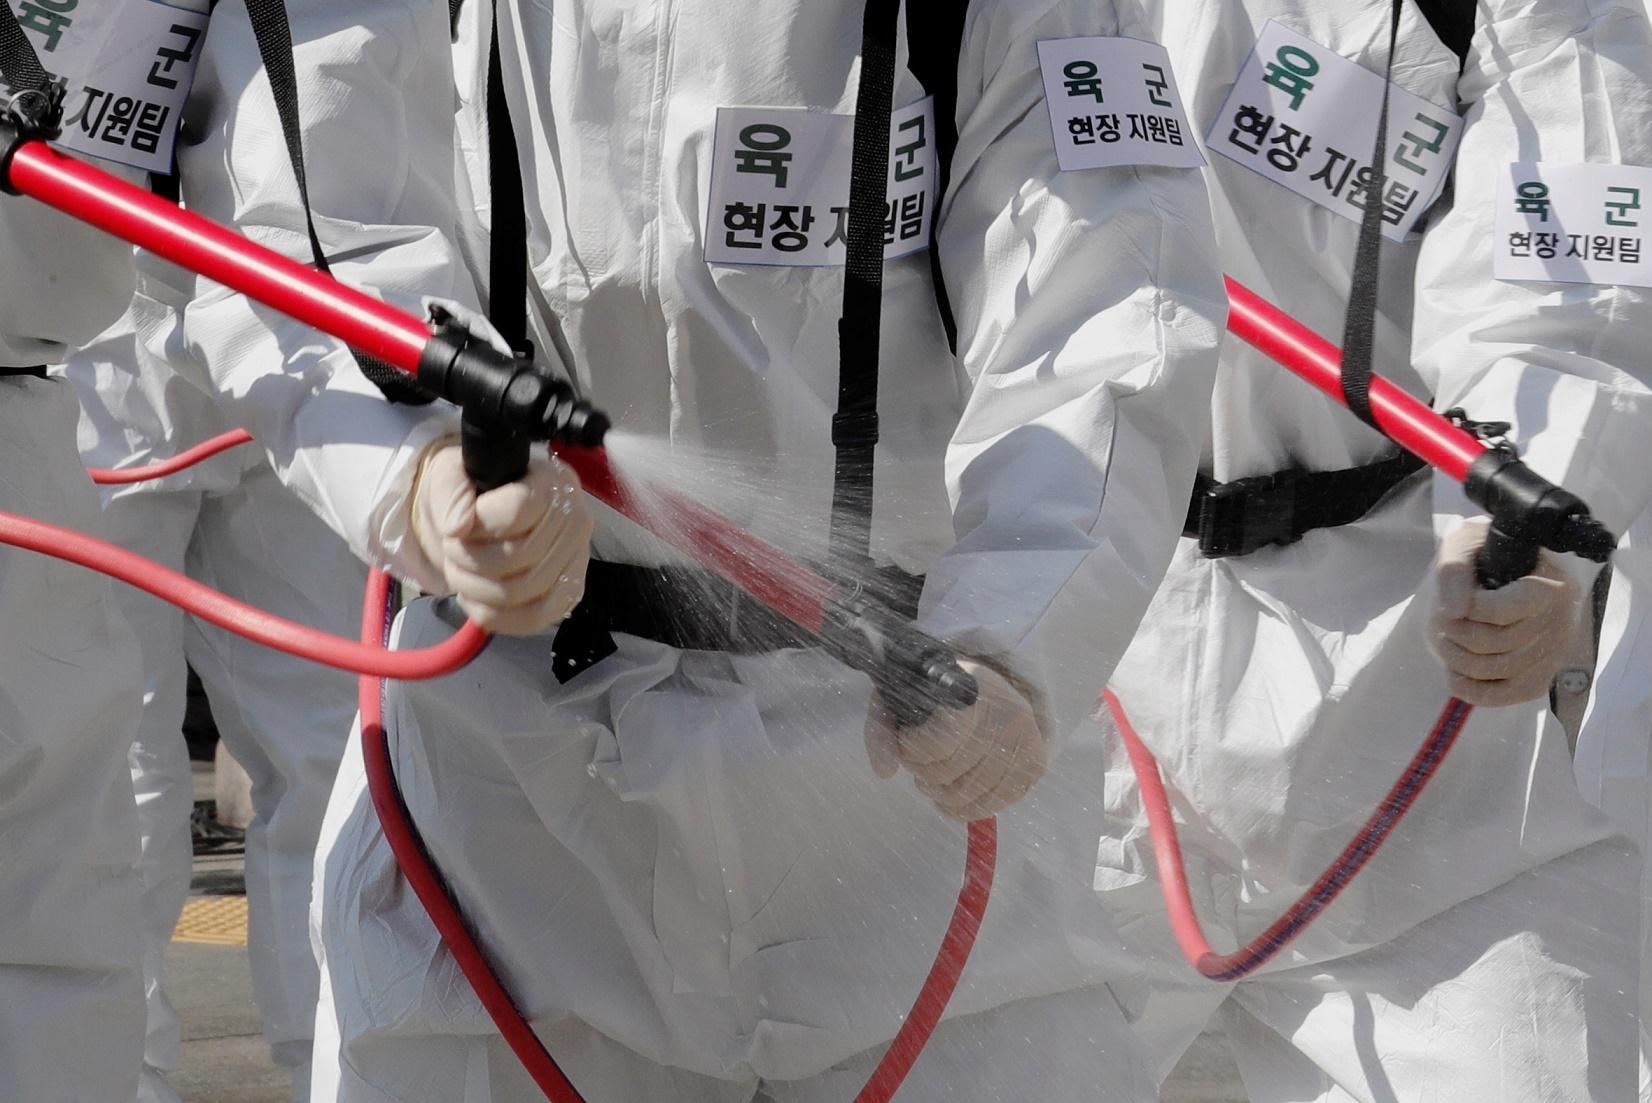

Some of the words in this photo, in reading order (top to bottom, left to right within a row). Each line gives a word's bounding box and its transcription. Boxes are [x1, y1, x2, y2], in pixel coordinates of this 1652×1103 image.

[146, 24, 202, 90] 군
[1063, 60, 1104, 103] 육
[1142, 63, 1172, 108] 군
[65, 86, 170, 154] 지원팀
[1067, 113, 1121, 146] 현장
[1126, 114, 1184, 147] 지원팀
[1262, 45, 1319, 112] 육
[1393, 112, 1449, 176] 군
[734, 123, 793, 189] 육
[894, 114, 926, 183] 군
[1228, 104, 1312, 172] 현장
[1309, 147, 1418, 226] 지원팀
[723, 201, 815, 252] 현장
[1514, 181, 1551, 222] 육
[1604, 186, 1641, 227] 군
[1508, 231, 1559, 259] 현장
[1565, 234, 1641, 264] 지원팀
